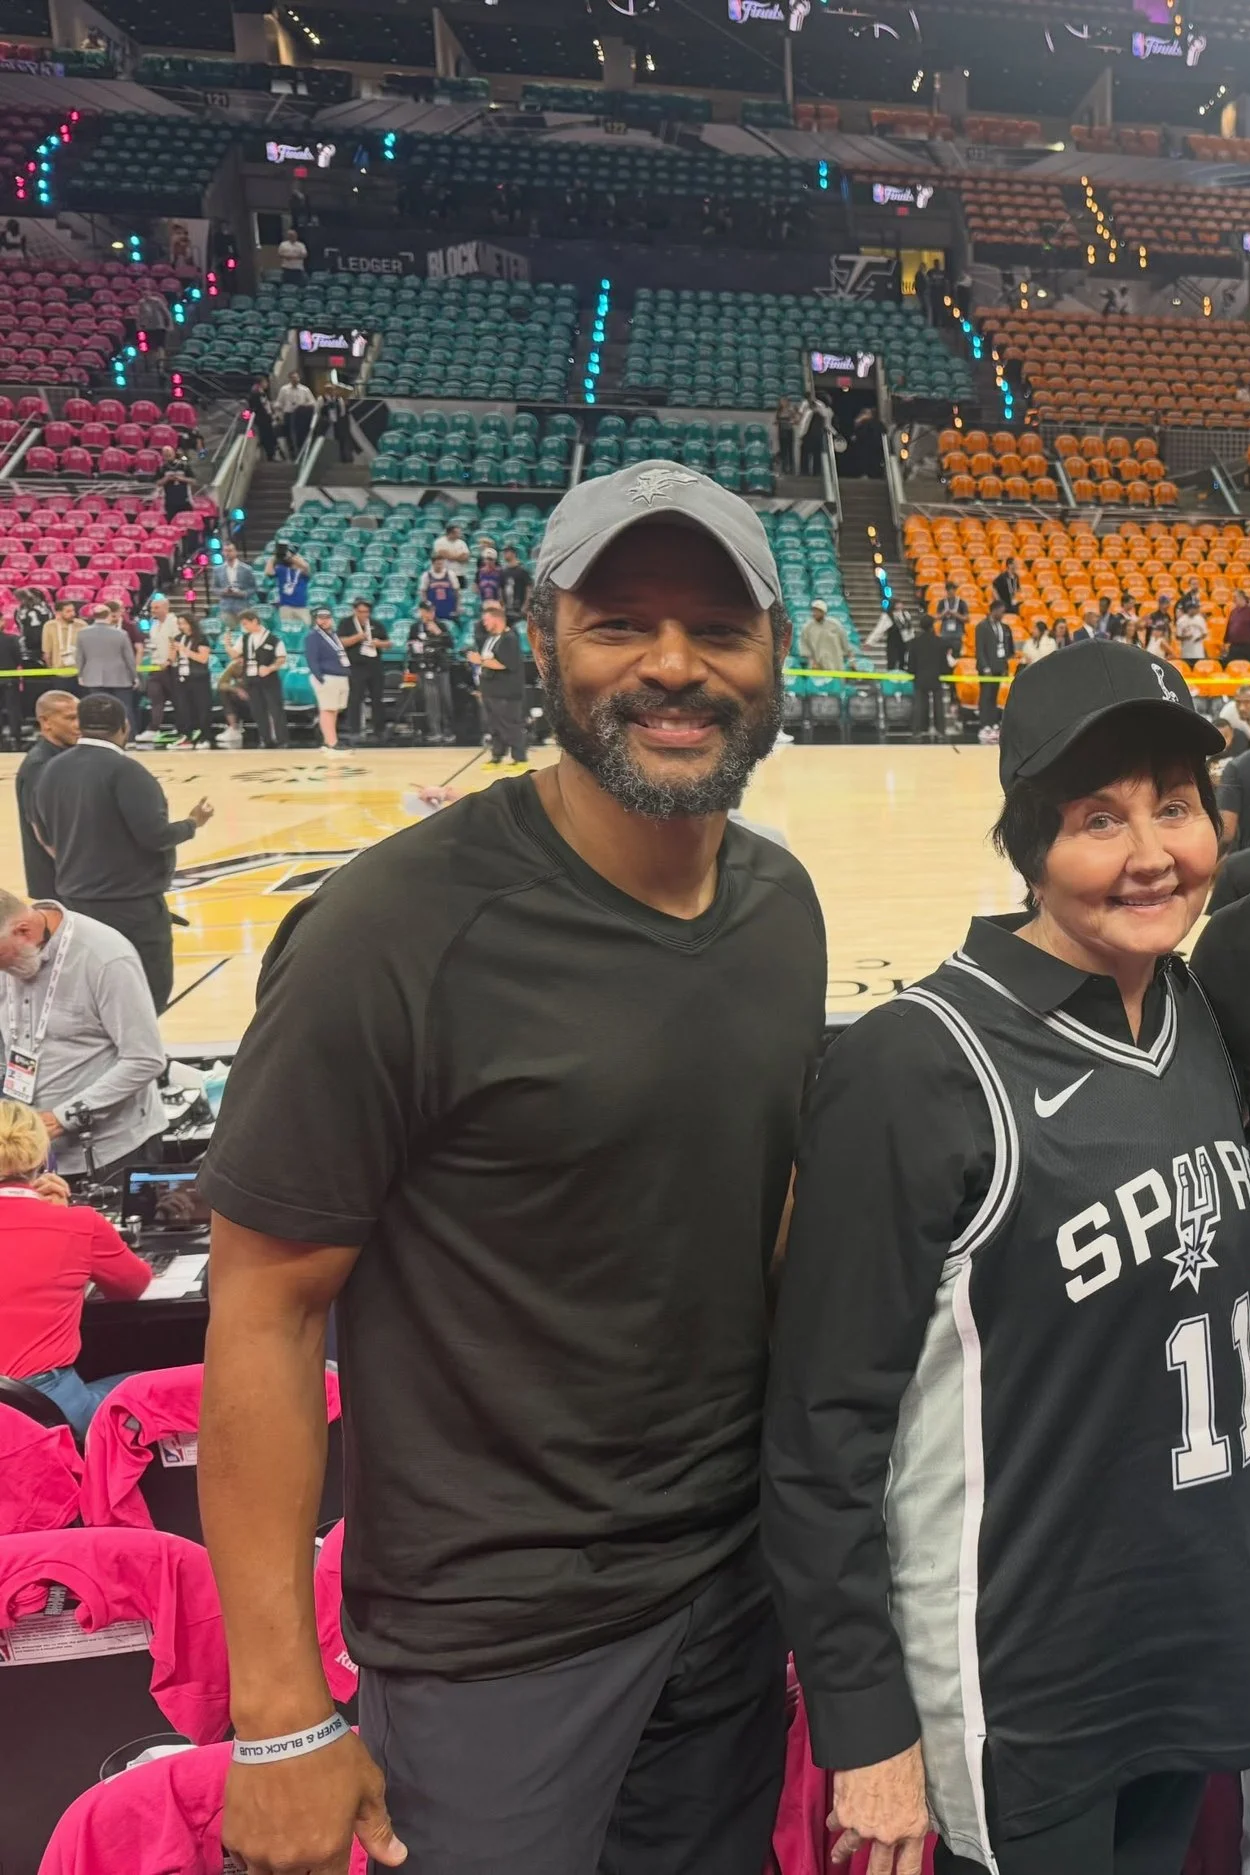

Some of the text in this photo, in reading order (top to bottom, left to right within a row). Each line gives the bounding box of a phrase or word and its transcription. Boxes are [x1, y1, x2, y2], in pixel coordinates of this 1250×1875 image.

[338, 256, 403, 273] LEDGER
[240, 1719, 343, 1757] SILVER & BLACK CLUB
